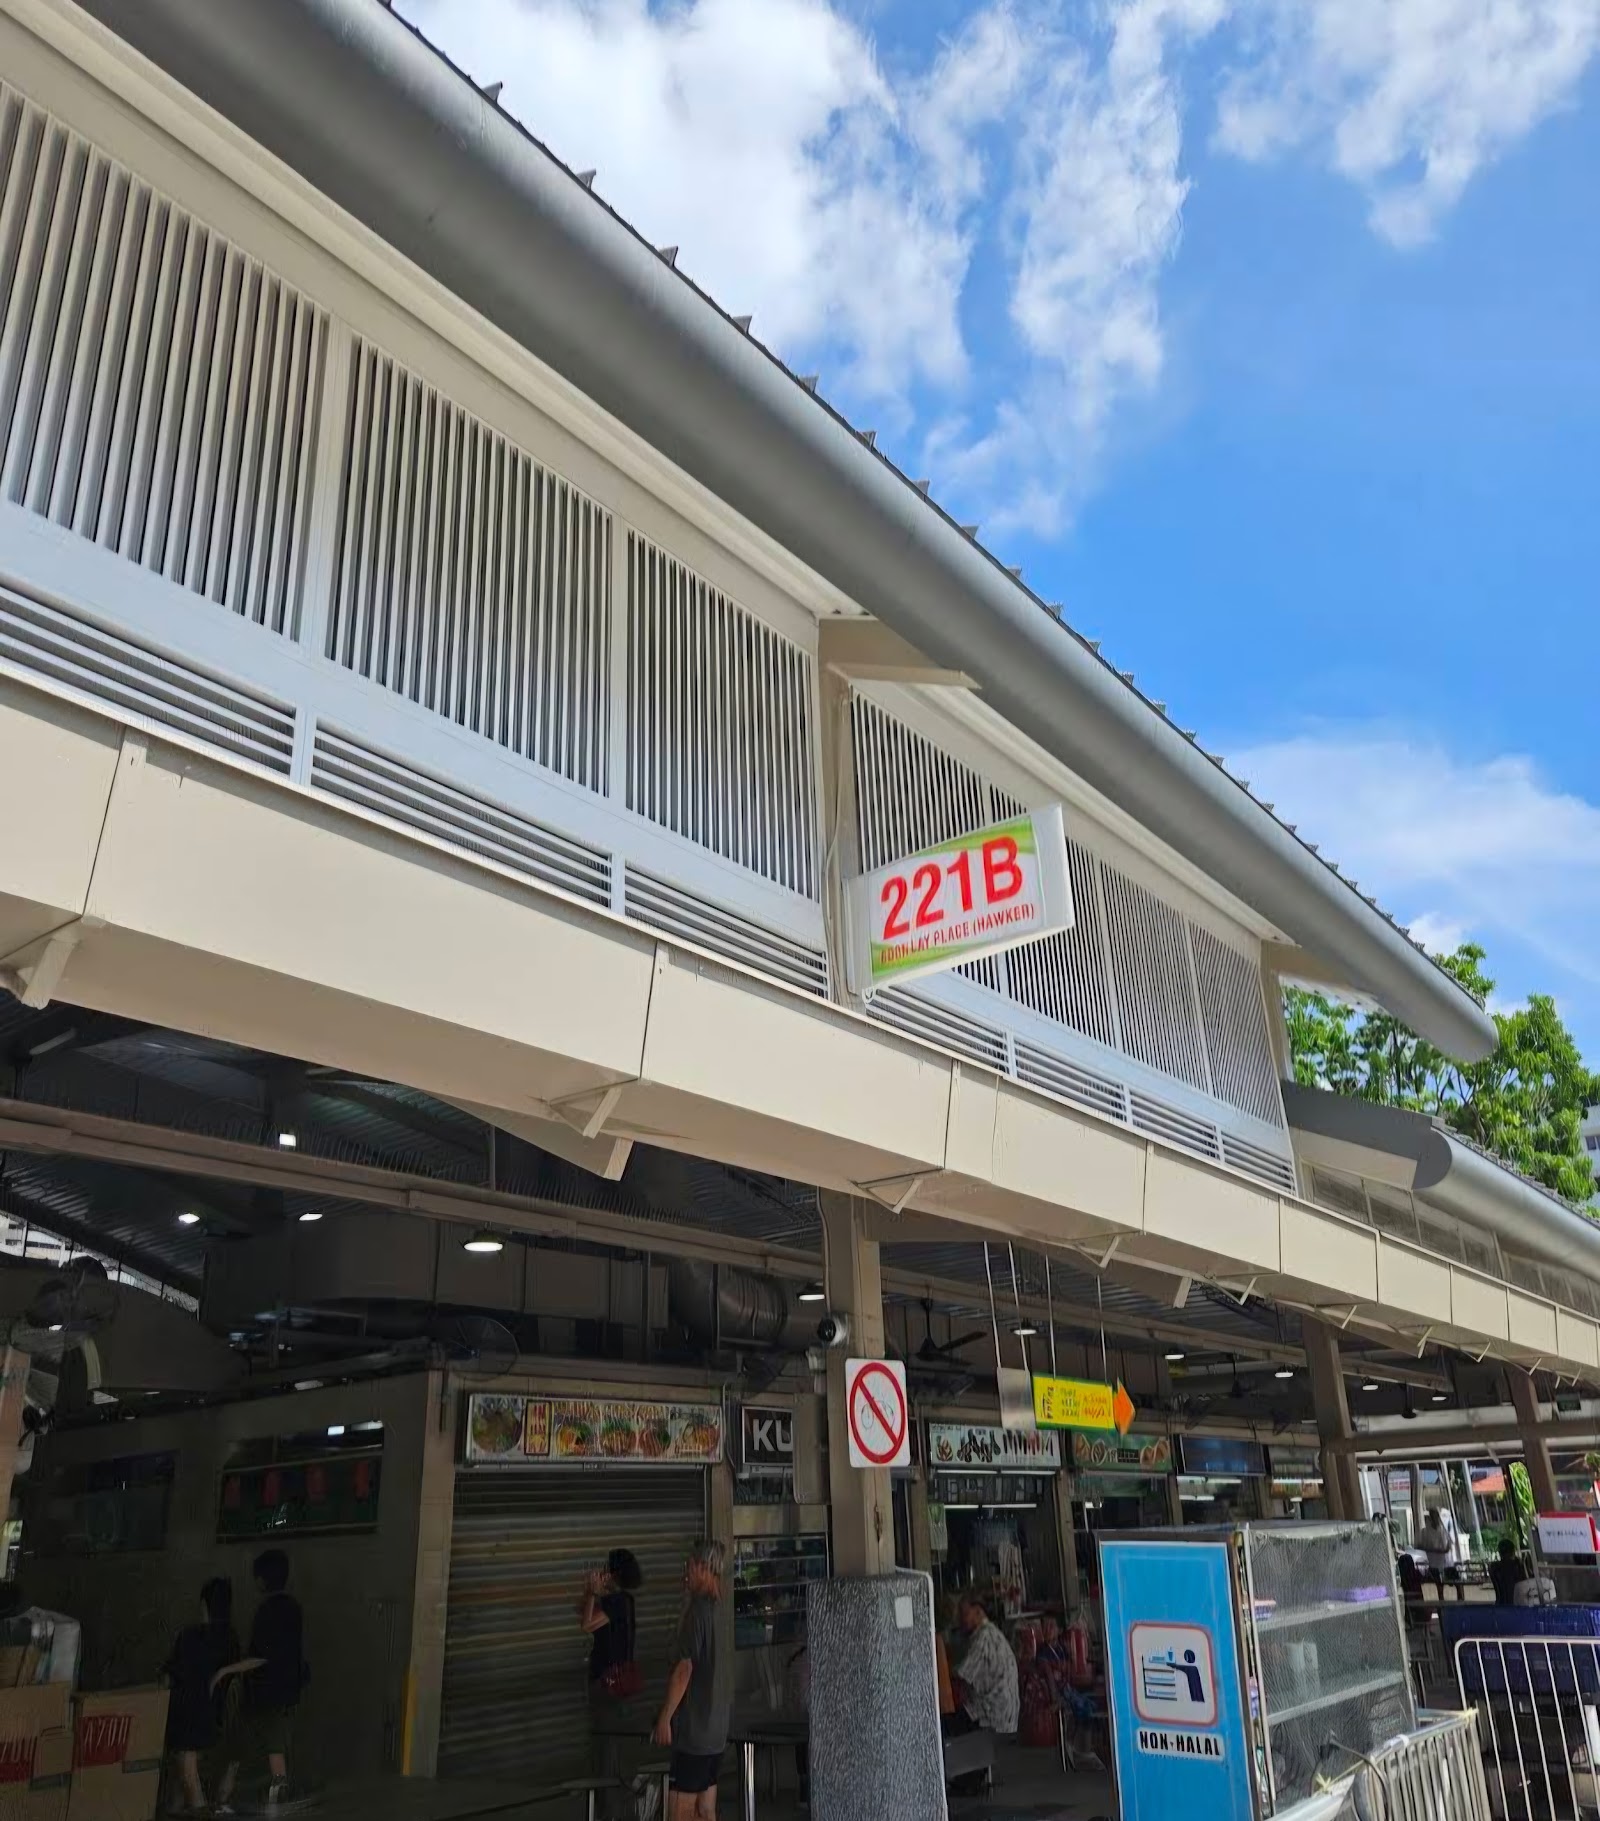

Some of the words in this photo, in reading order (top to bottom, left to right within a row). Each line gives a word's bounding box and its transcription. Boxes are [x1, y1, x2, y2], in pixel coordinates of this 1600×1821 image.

[881, 836, 1023, 940] 221B
[910, 933, 930, 953] LAY
[933, 921, 969, 946] PLACE
[973, 903, 1034, 936] (HAWKER)
